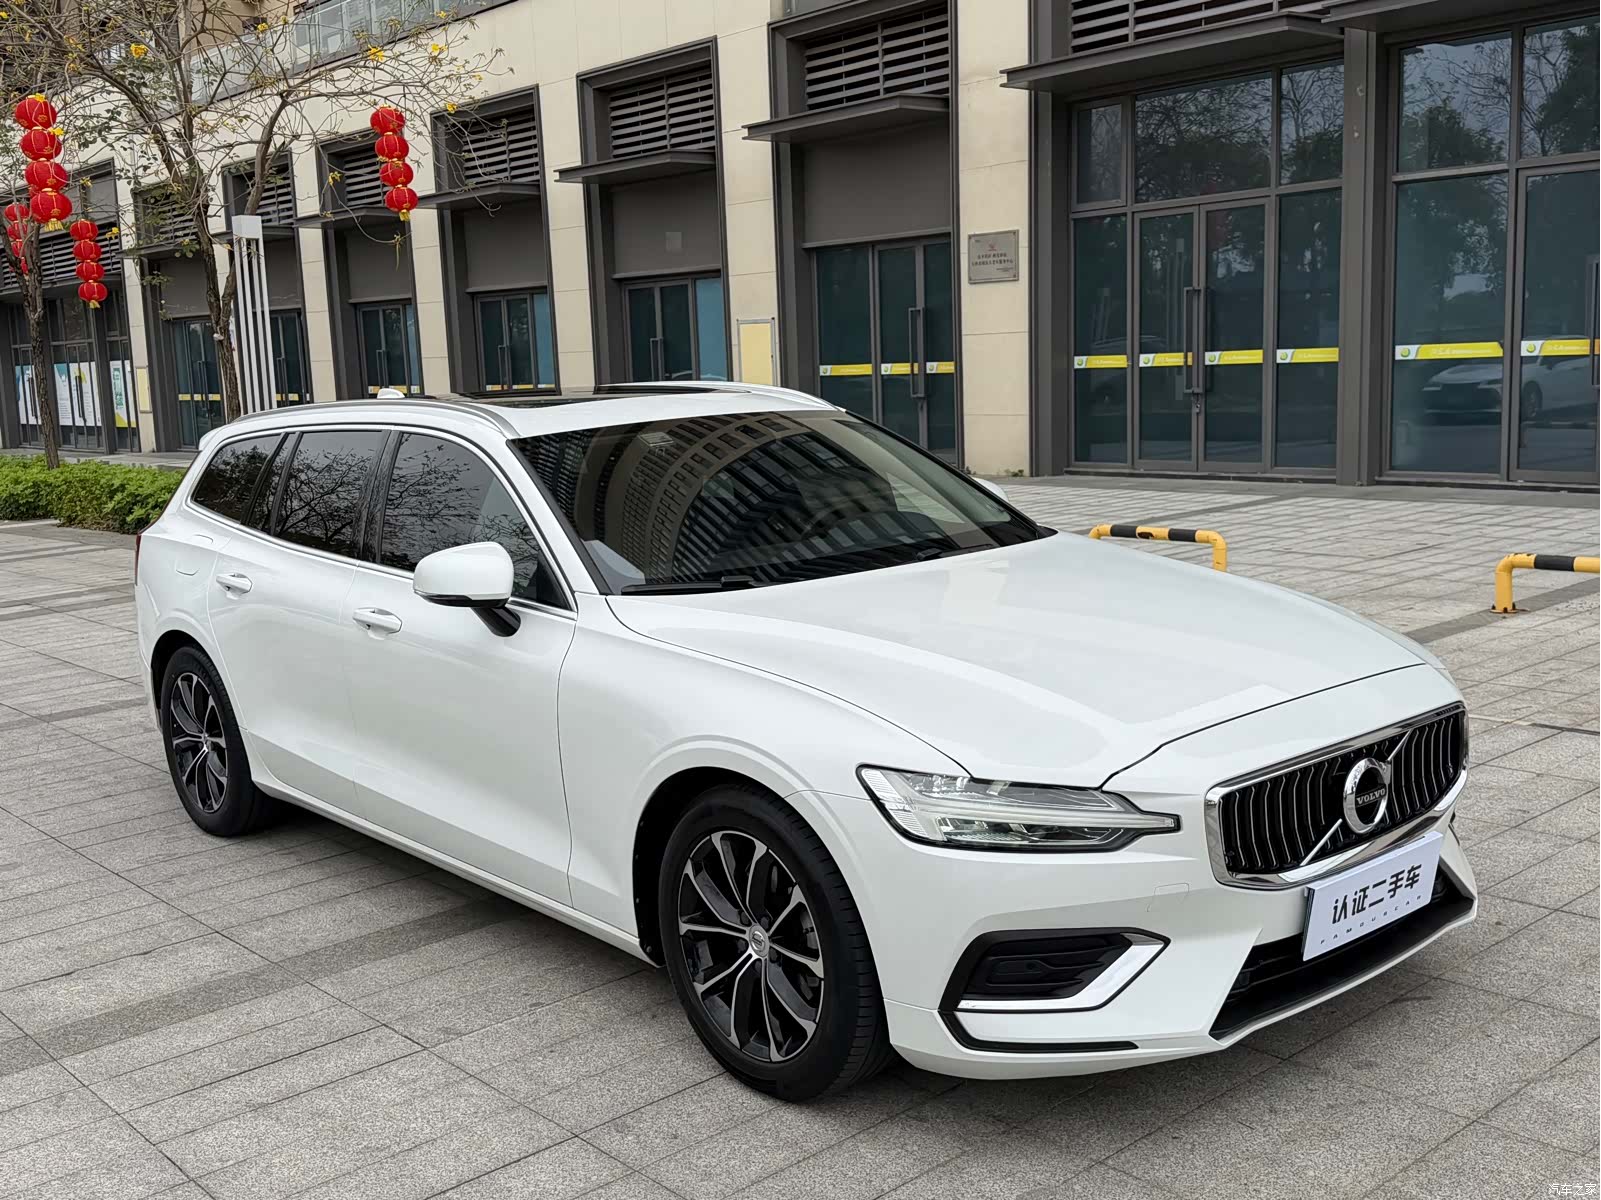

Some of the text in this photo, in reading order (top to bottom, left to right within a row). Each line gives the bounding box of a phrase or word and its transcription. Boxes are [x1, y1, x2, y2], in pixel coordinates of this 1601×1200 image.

[1357, 788, 1386, 804] VOLVO
[1332, 864, 1422, 924] 认证二手车
